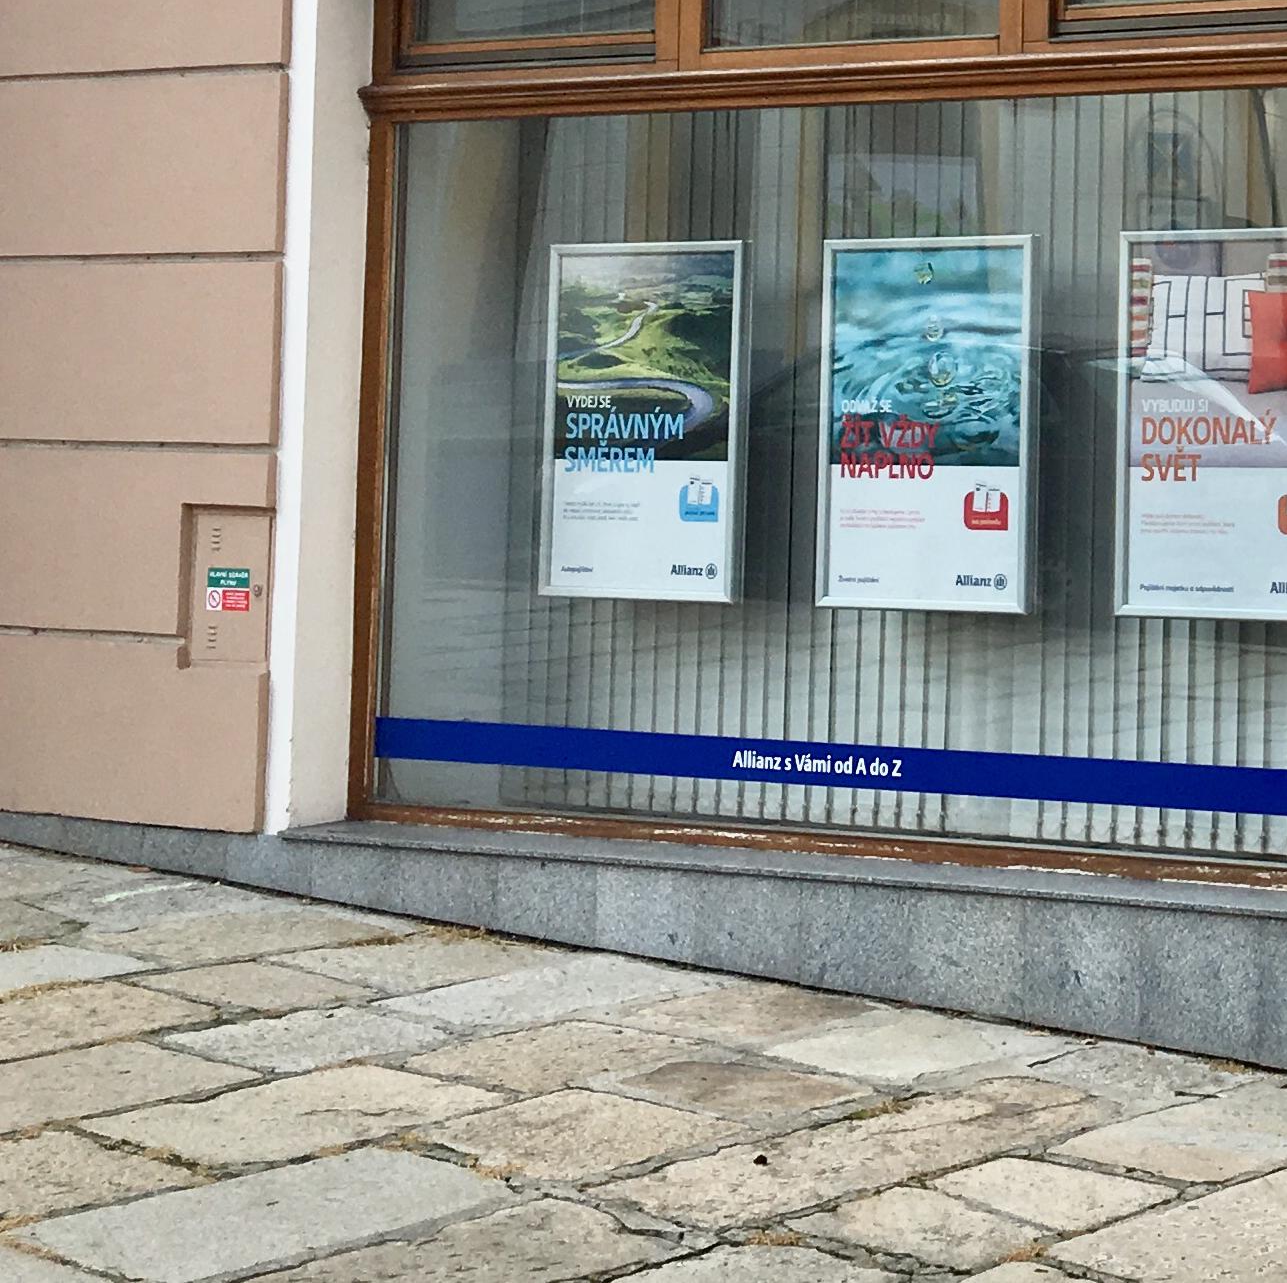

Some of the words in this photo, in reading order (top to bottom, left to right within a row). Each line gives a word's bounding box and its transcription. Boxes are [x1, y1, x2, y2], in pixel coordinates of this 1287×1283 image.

[566, 395, 598, 409] VYDEJ
[599, 396, 612, 409] SE
[879, 399, 893, 413] SE
[565, 406, 684, 440] SPRÁVNÝM
[1141, 409, 1277, 446] DOKONALÝ
[564, 439, 656, 473] SMĚREM
[840, 452, 935, 480] NAPLNO
[1140, 446, 1202, 482] SVĚT
[670, 564, 704, 577] Allianz
[955, 574, 992, 587] Allianz
[733, 750, 782, 771] Allianz
[784, 757, 792, 771] s
[794, 753, 831, 774] Vámi
[834, 756, 853, 775] od
[856, 758, 867, 776] A
[870, 757, 889, 777] do
[892, 760, 902, 777] Z
